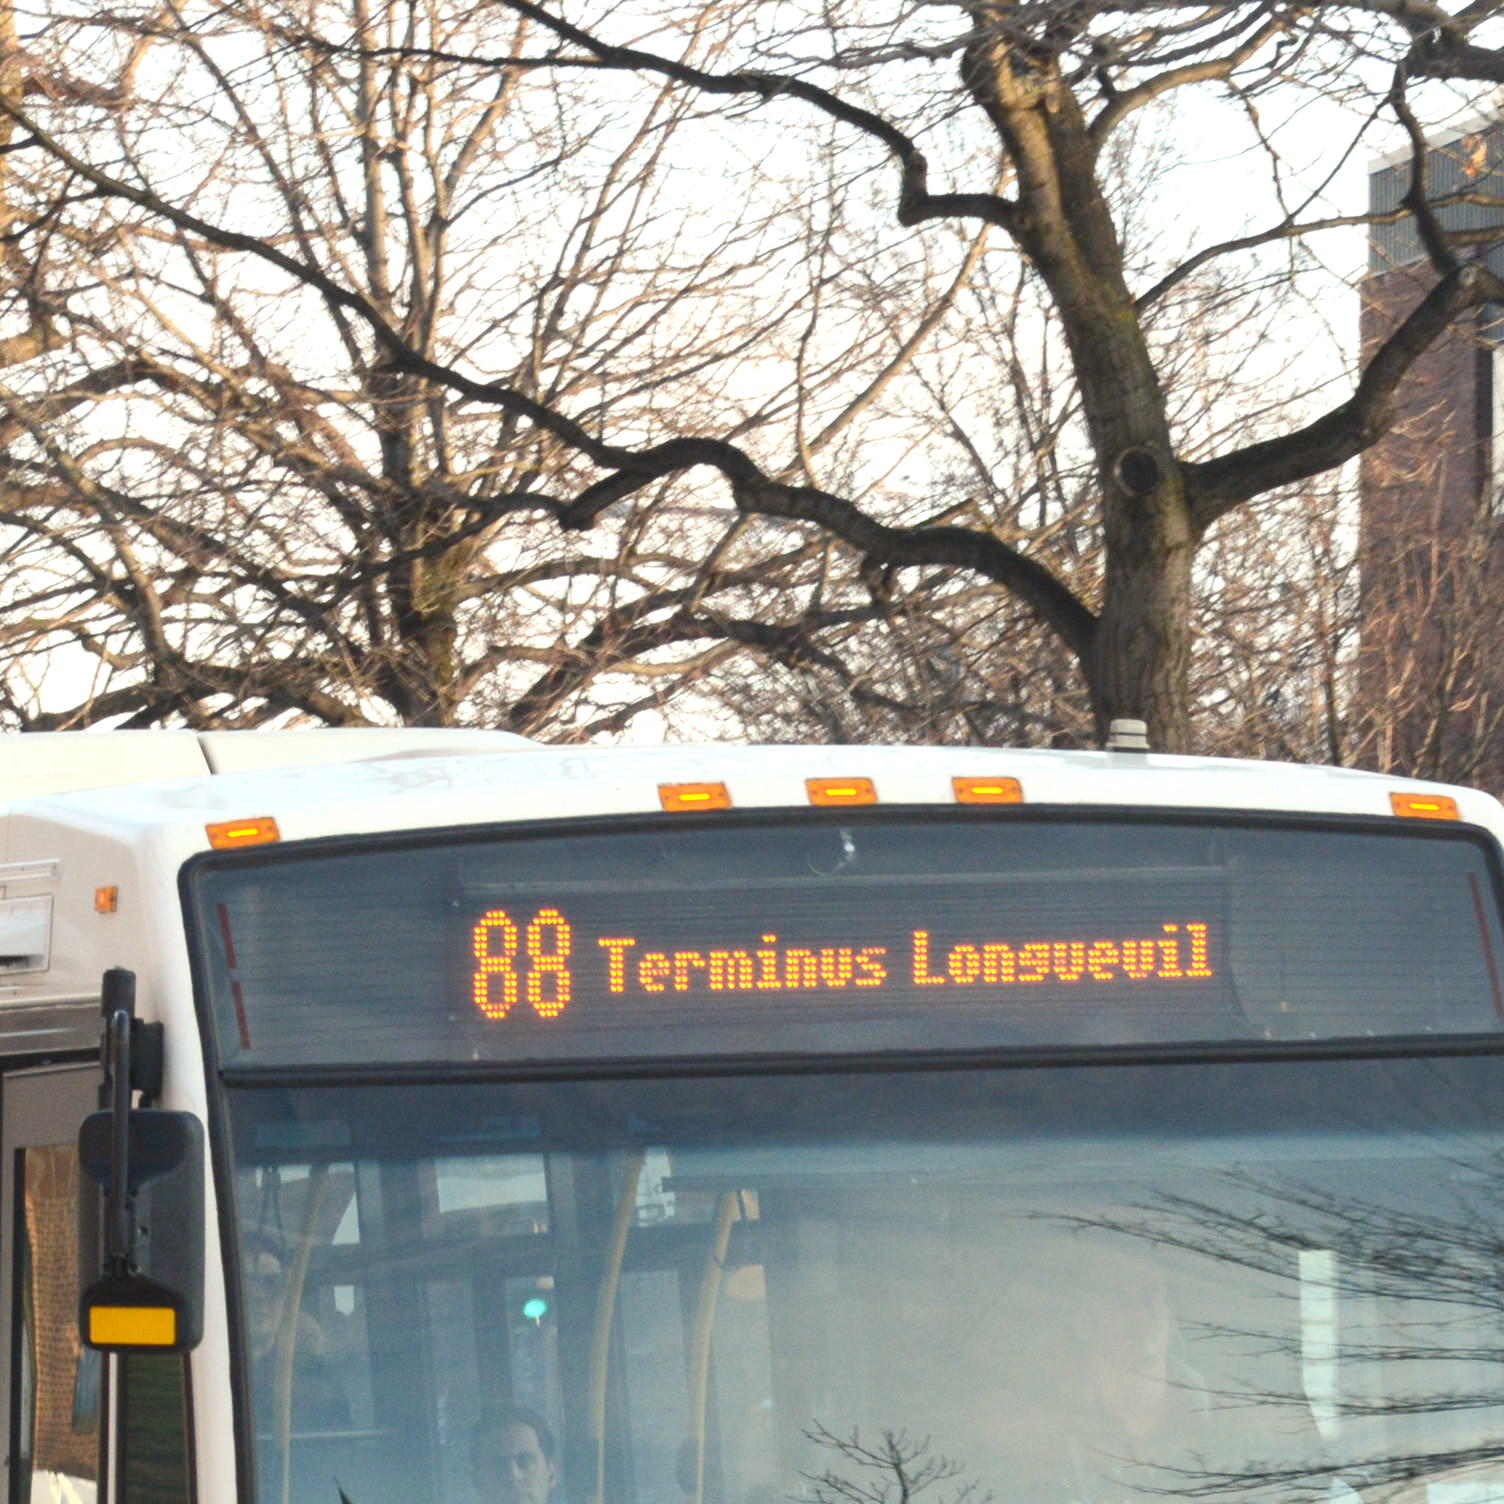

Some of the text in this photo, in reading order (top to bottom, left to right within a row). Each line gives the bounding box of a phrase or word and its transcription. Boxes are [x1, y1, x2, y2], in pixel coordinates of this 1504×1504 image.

[473, 908, 1213, 1018] 88 Terminus Longueuil
